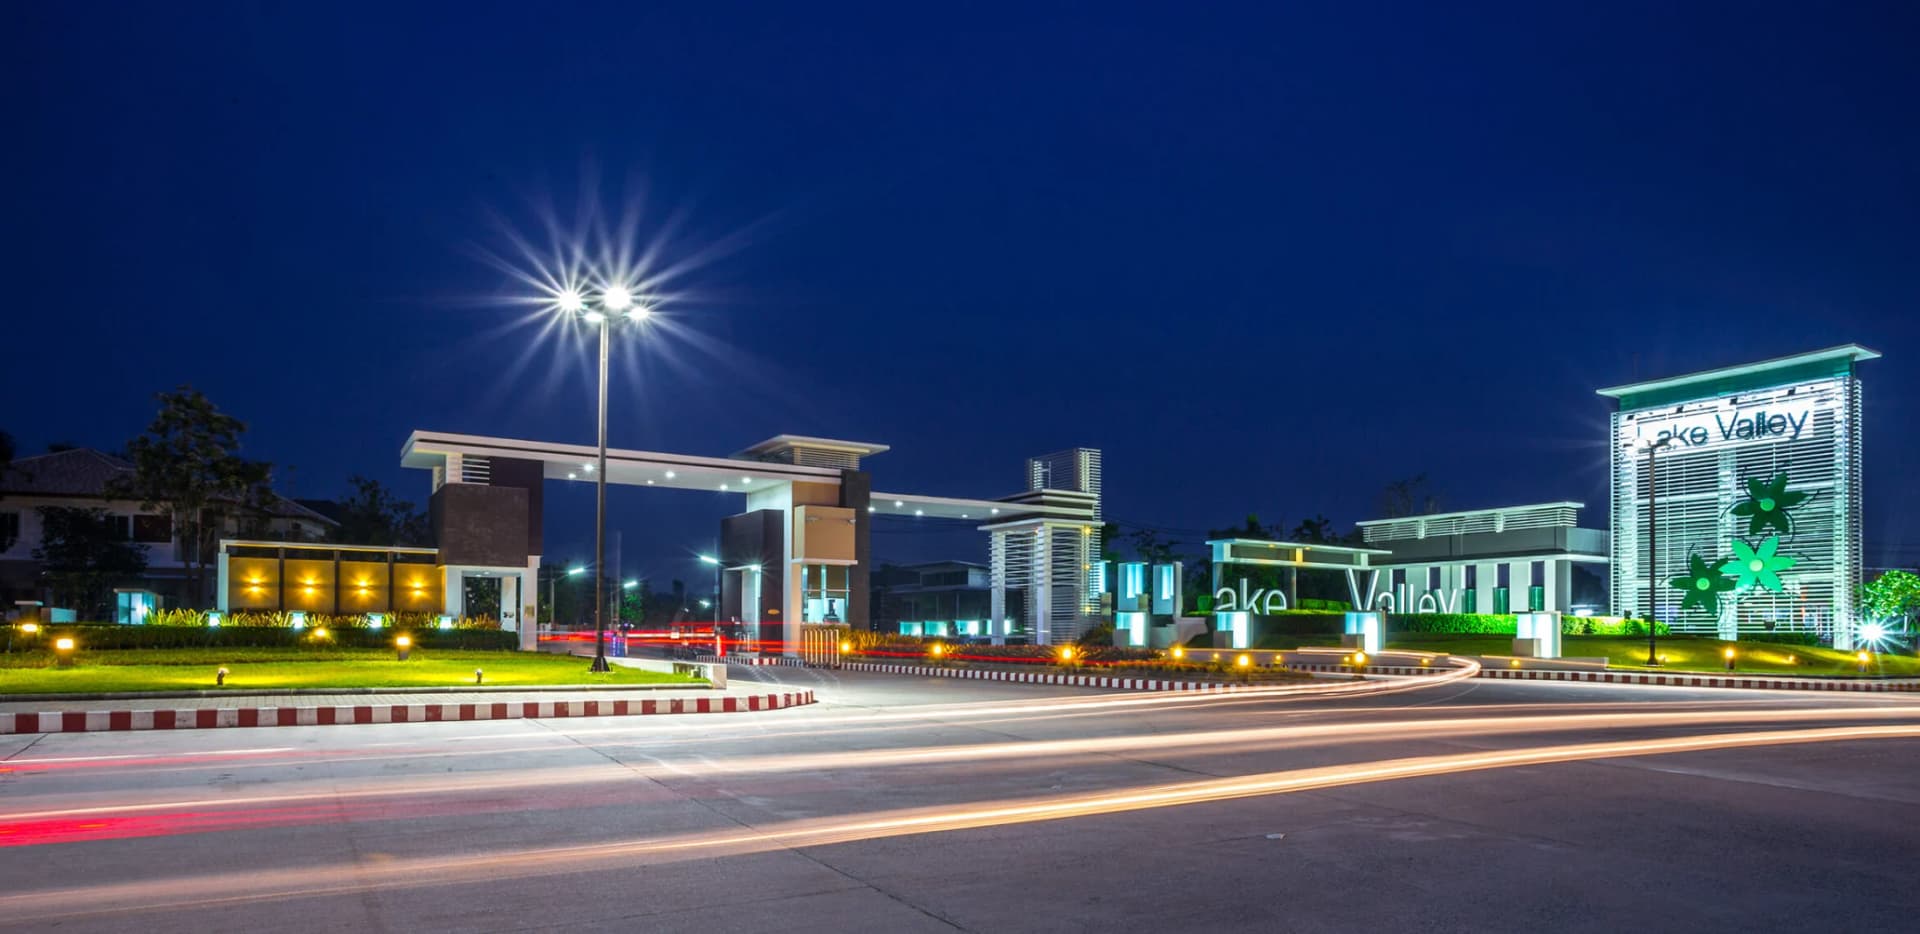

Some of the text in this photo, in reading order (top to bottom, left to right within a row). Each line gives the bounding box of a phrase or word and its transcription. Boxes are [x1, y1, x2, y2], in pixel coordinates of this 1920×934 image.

[1715, 410, 1809, 440] Valley
[1214, 567, 1457, 615] ake Valley
